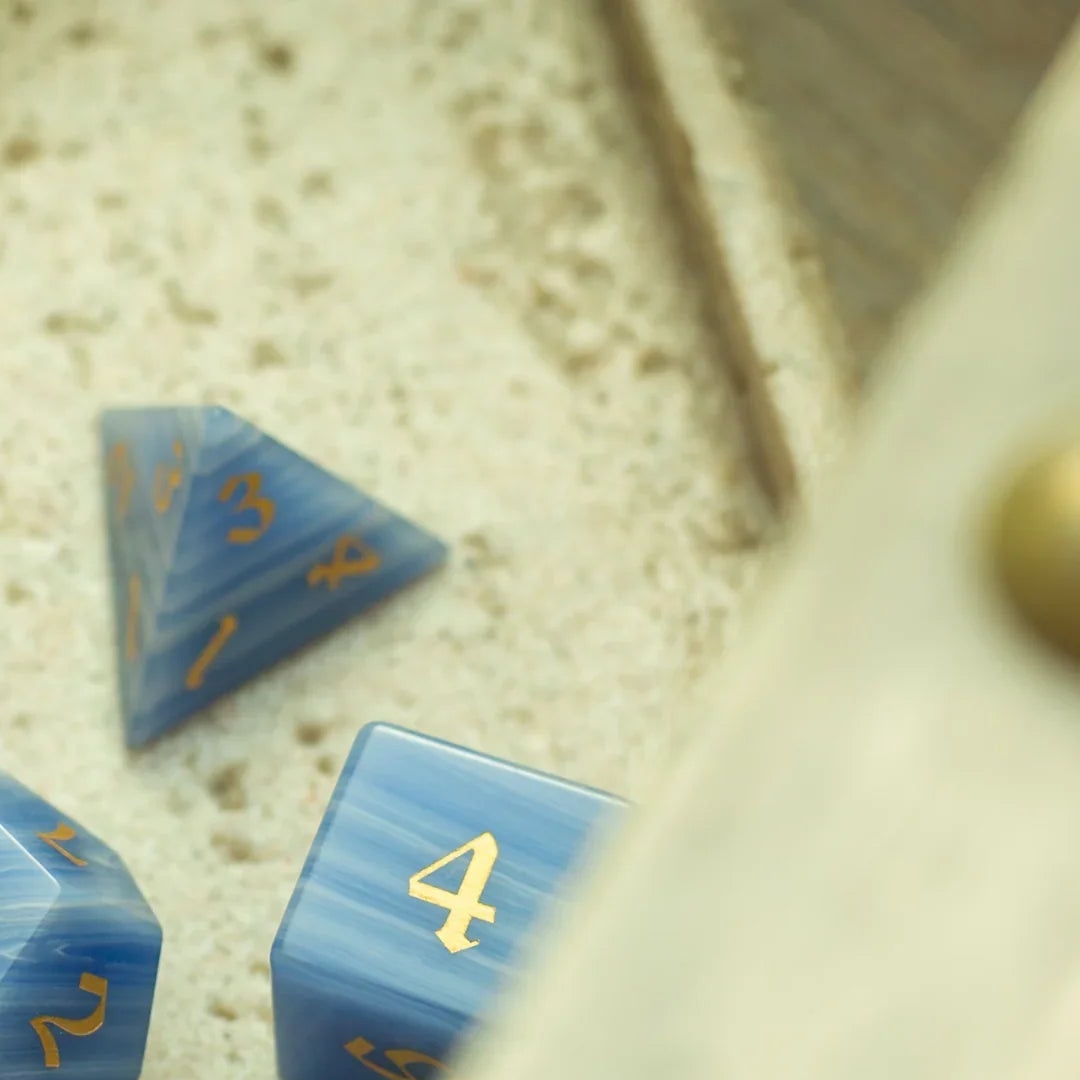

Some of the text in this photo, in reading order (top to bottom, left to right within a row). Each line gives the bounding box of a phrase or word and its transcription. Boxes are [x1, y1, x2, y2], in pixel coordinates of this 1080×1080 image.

[219, 472, 275, 544] 3
[306, 534, 381, 589] 4
[185, 613, 238, 690] 1
[408, 831, 499, 954] 4
